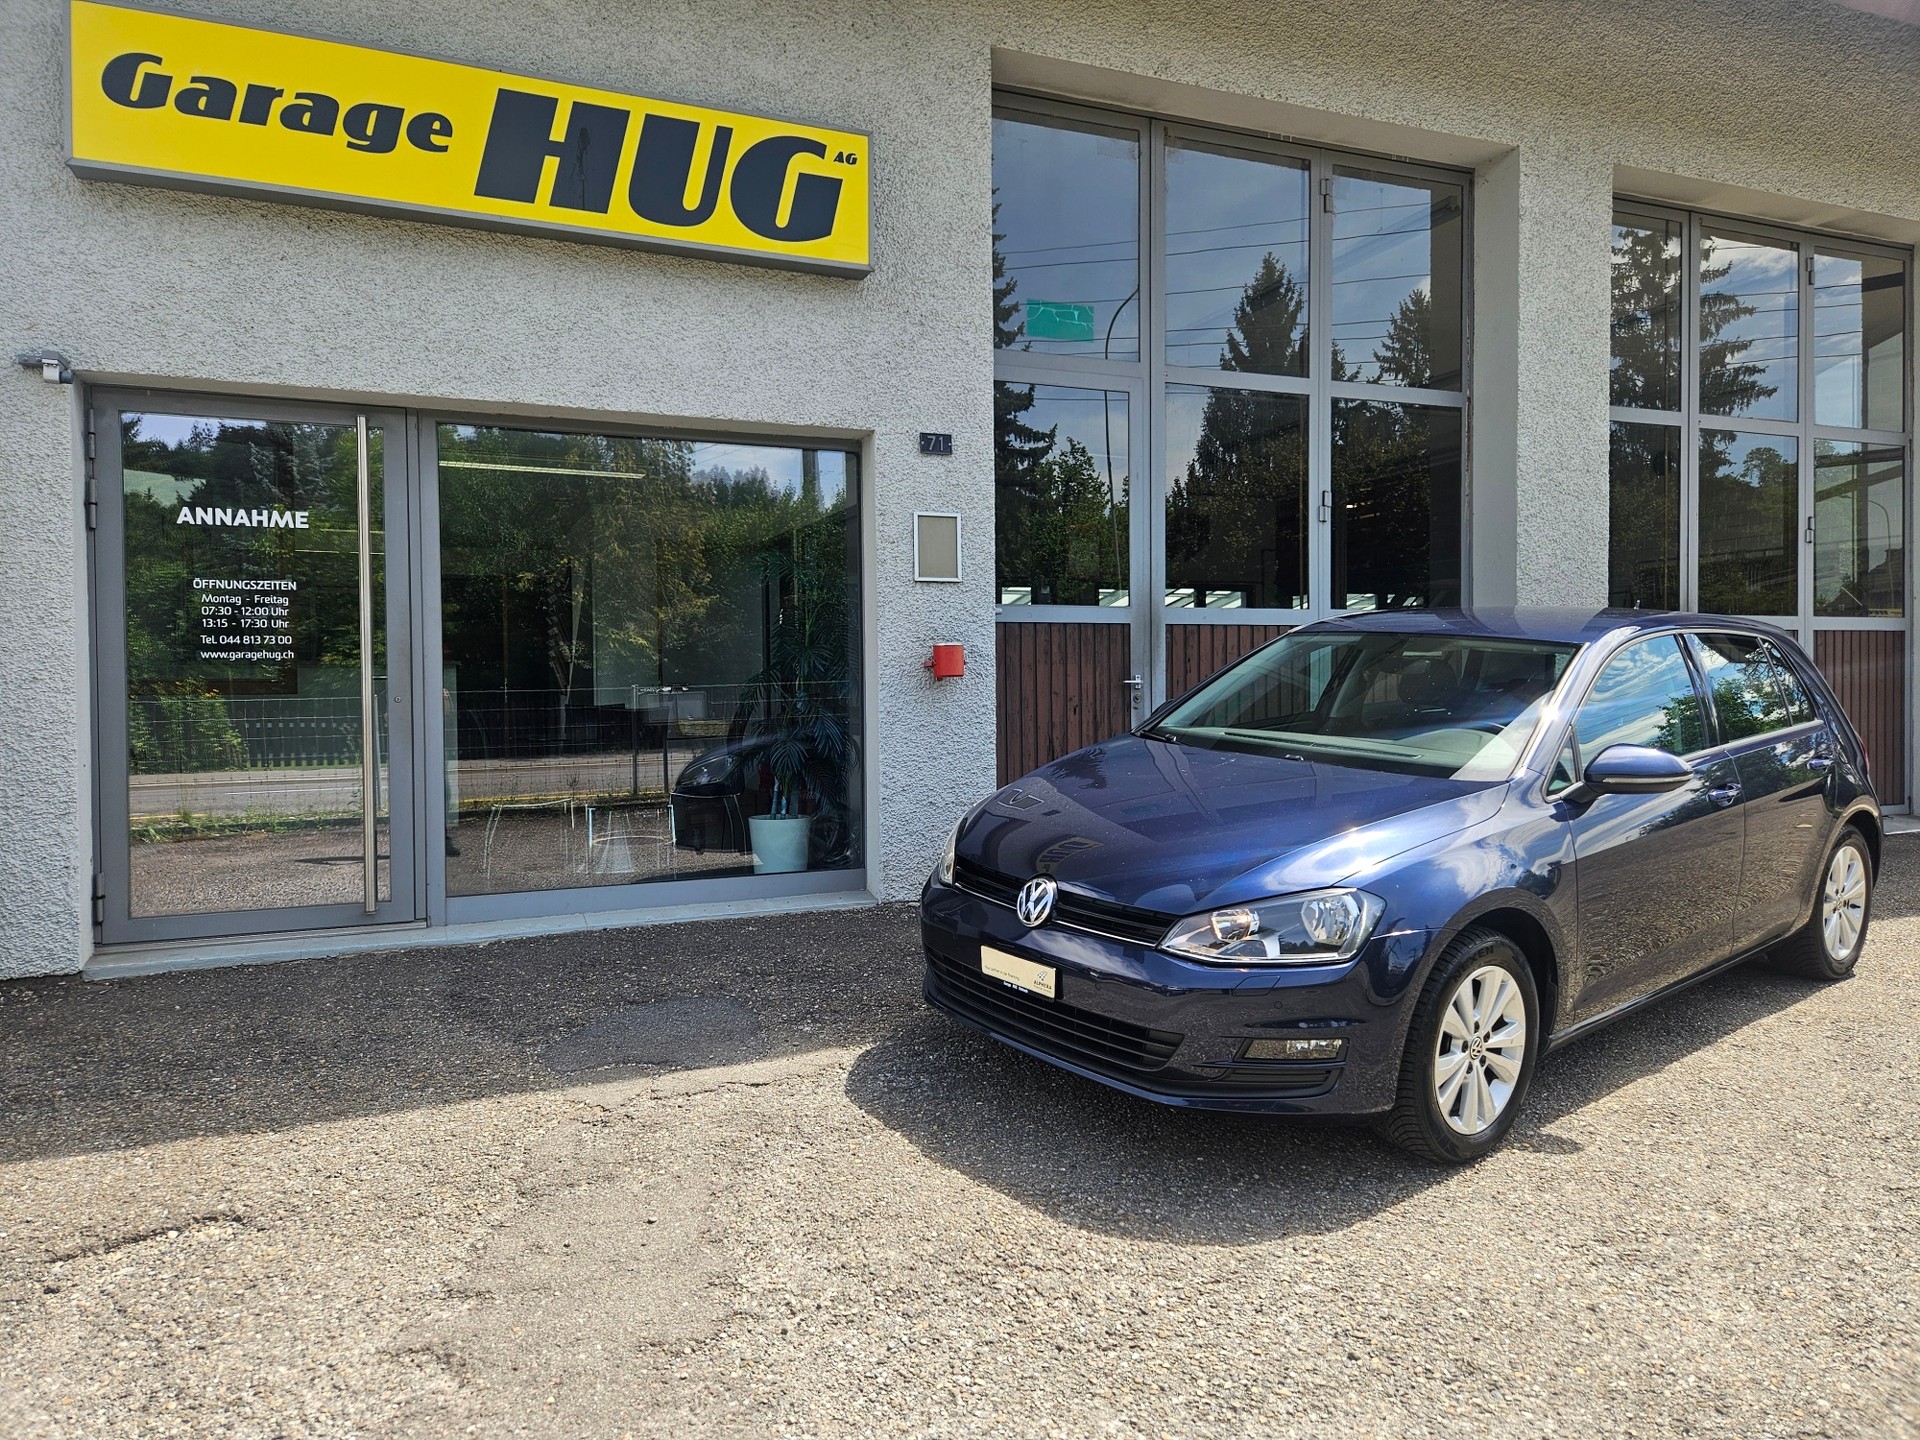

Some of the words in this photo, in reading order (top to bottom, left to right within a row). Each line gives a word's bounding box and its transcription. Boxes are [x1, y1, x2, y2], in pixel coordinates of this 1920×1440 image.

[101, 52, 454, 154] Garage
[473, 88, 843, 243] HUG
[833, 151, 858, 165] AG
[927, 435, 944, 451] 71
[177, 506, 309, 529] ANNAHME
[193, 578, 297, 591] ÖFFNUNGSZEITEN
[201, 594, 242, 605] Montag
[254, 594, 289, 606] Freitag
[201, 606, 232, 615] 07:30
[241, 606, 269, 616] 12:00
[271, 607, 289, 616] Uhr
[202, 619, 228, 628] 13:15
[240, 619, 267, 628] 17:30
[271, 619, 289, 628] Uhr
[220, 635, 240, 644] 044
[243, 635, 261, 644] 813
[263, 635, 276, 644] 73
[277, 635, 292, 644] 00
[200, 650, 294, 661] www.garagehug.ch
